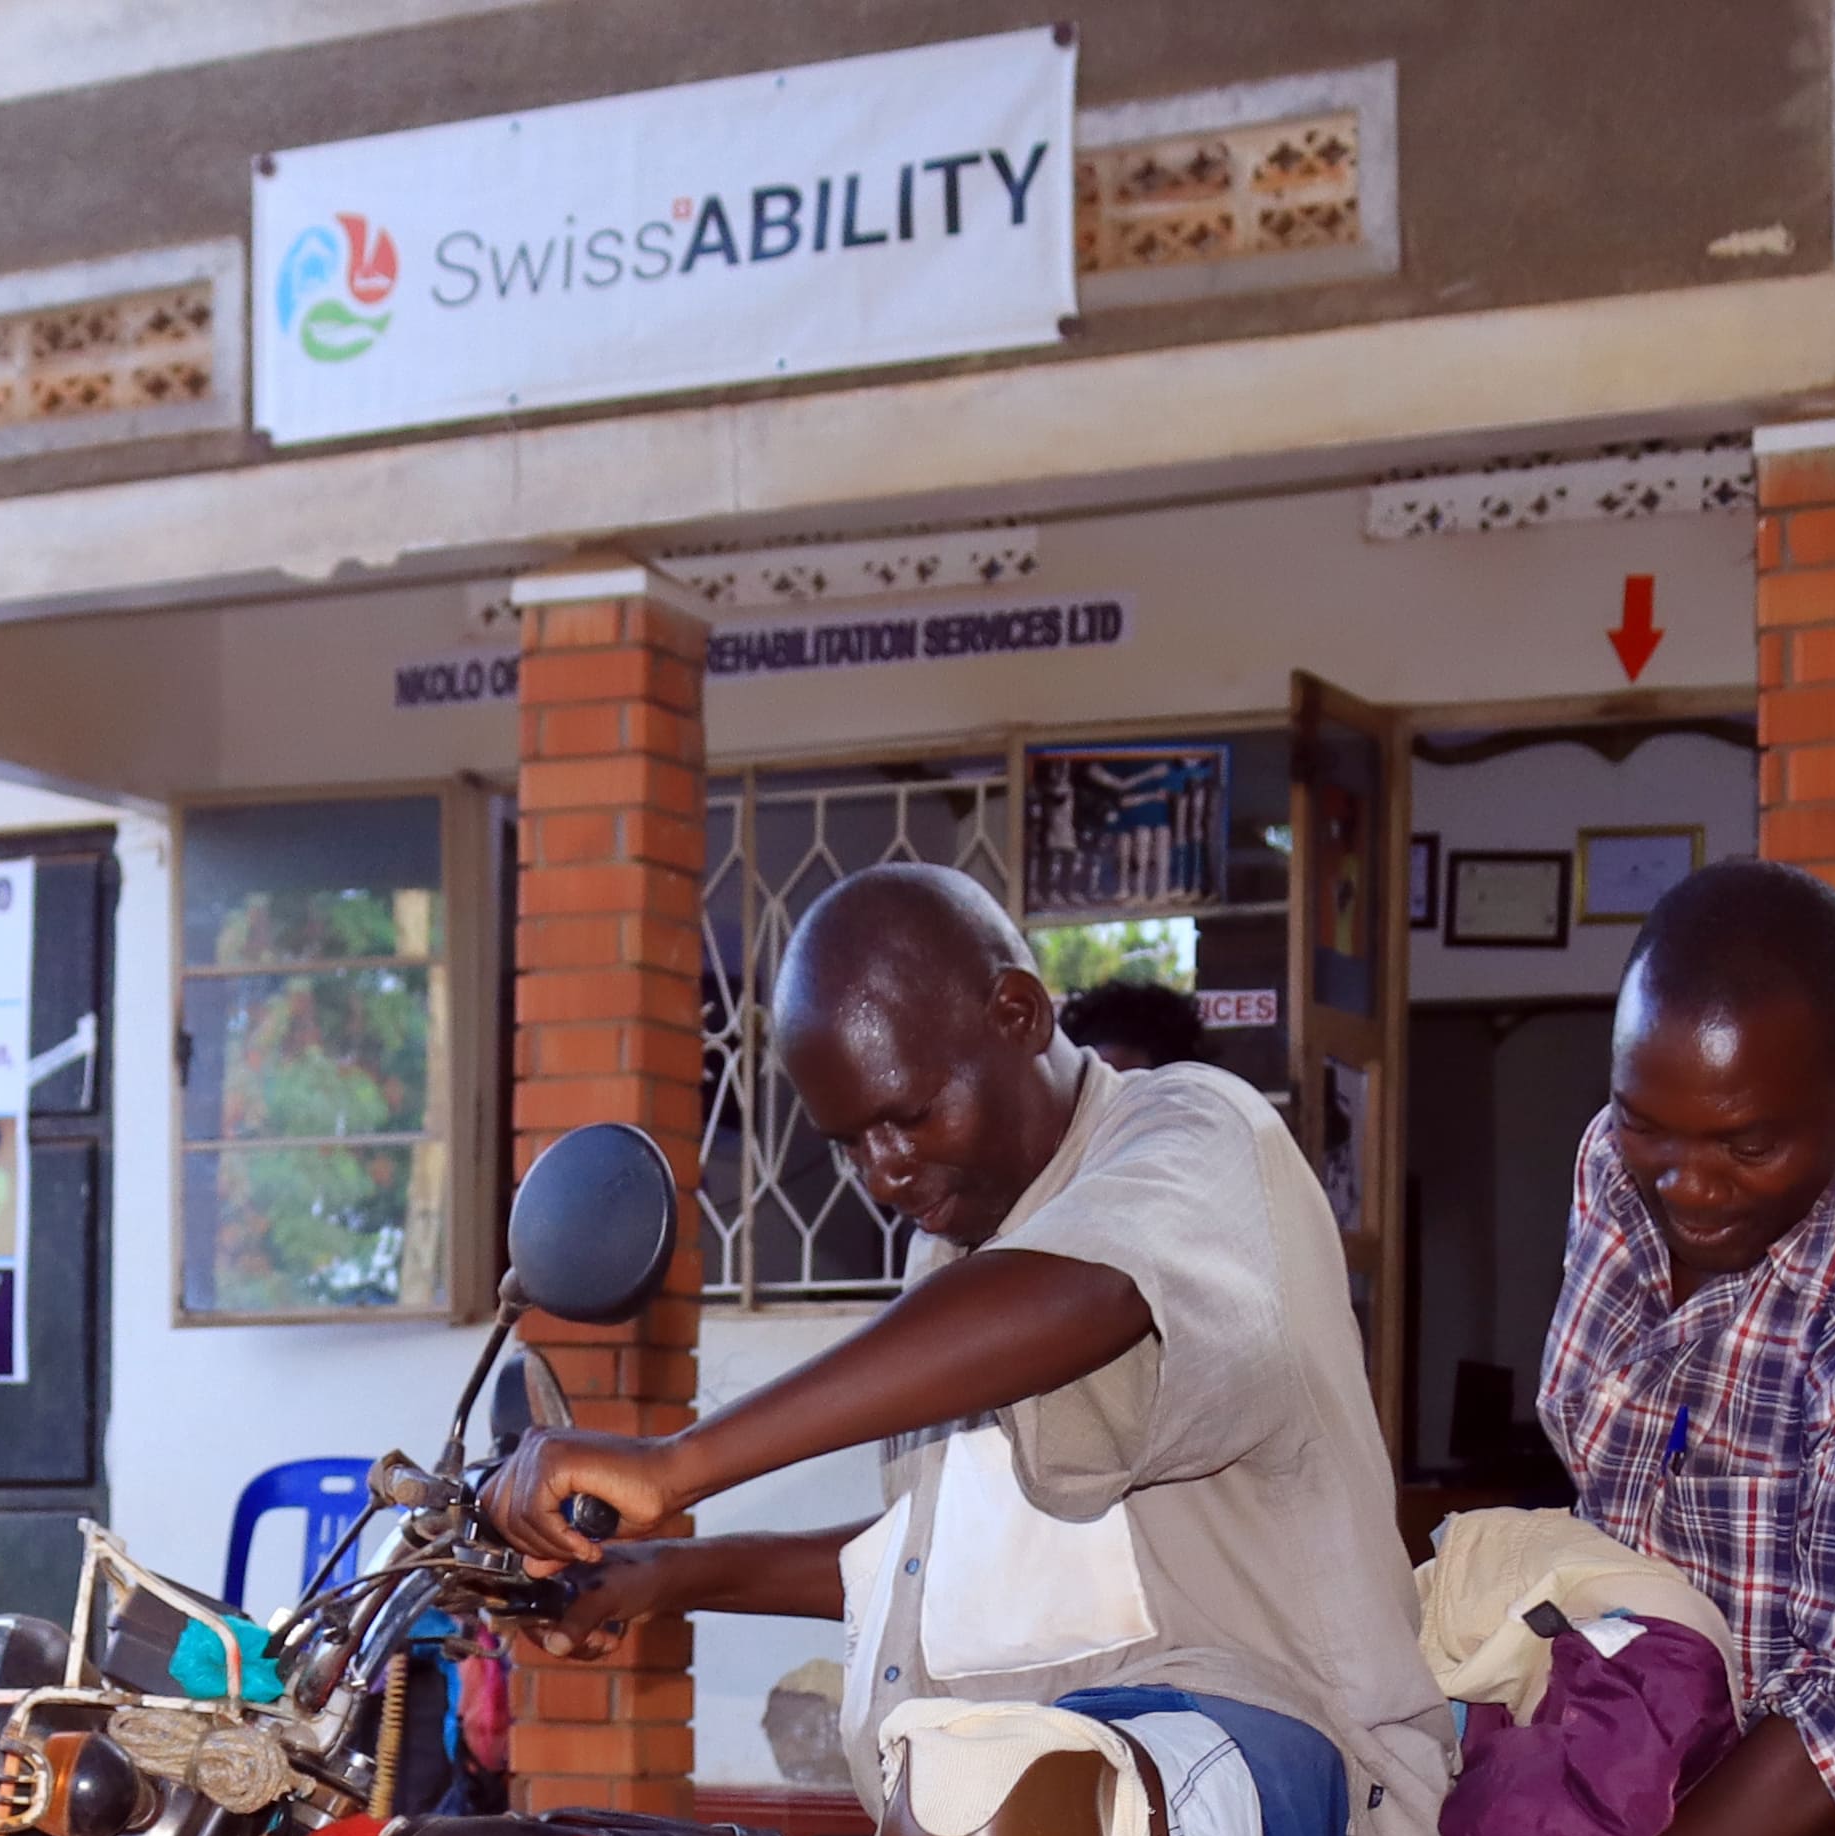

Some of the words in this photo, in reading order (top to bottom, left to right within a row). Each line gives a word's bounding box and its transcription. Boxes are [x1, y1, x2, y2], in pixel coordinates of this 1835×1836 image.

[433, 142, 1049, 307] SwissABILITY
[395, 659, 483, 706] NKOLO
[924, 606, 1062, 658] SERVICES
[1068, 601, 1123, 645] LTD
